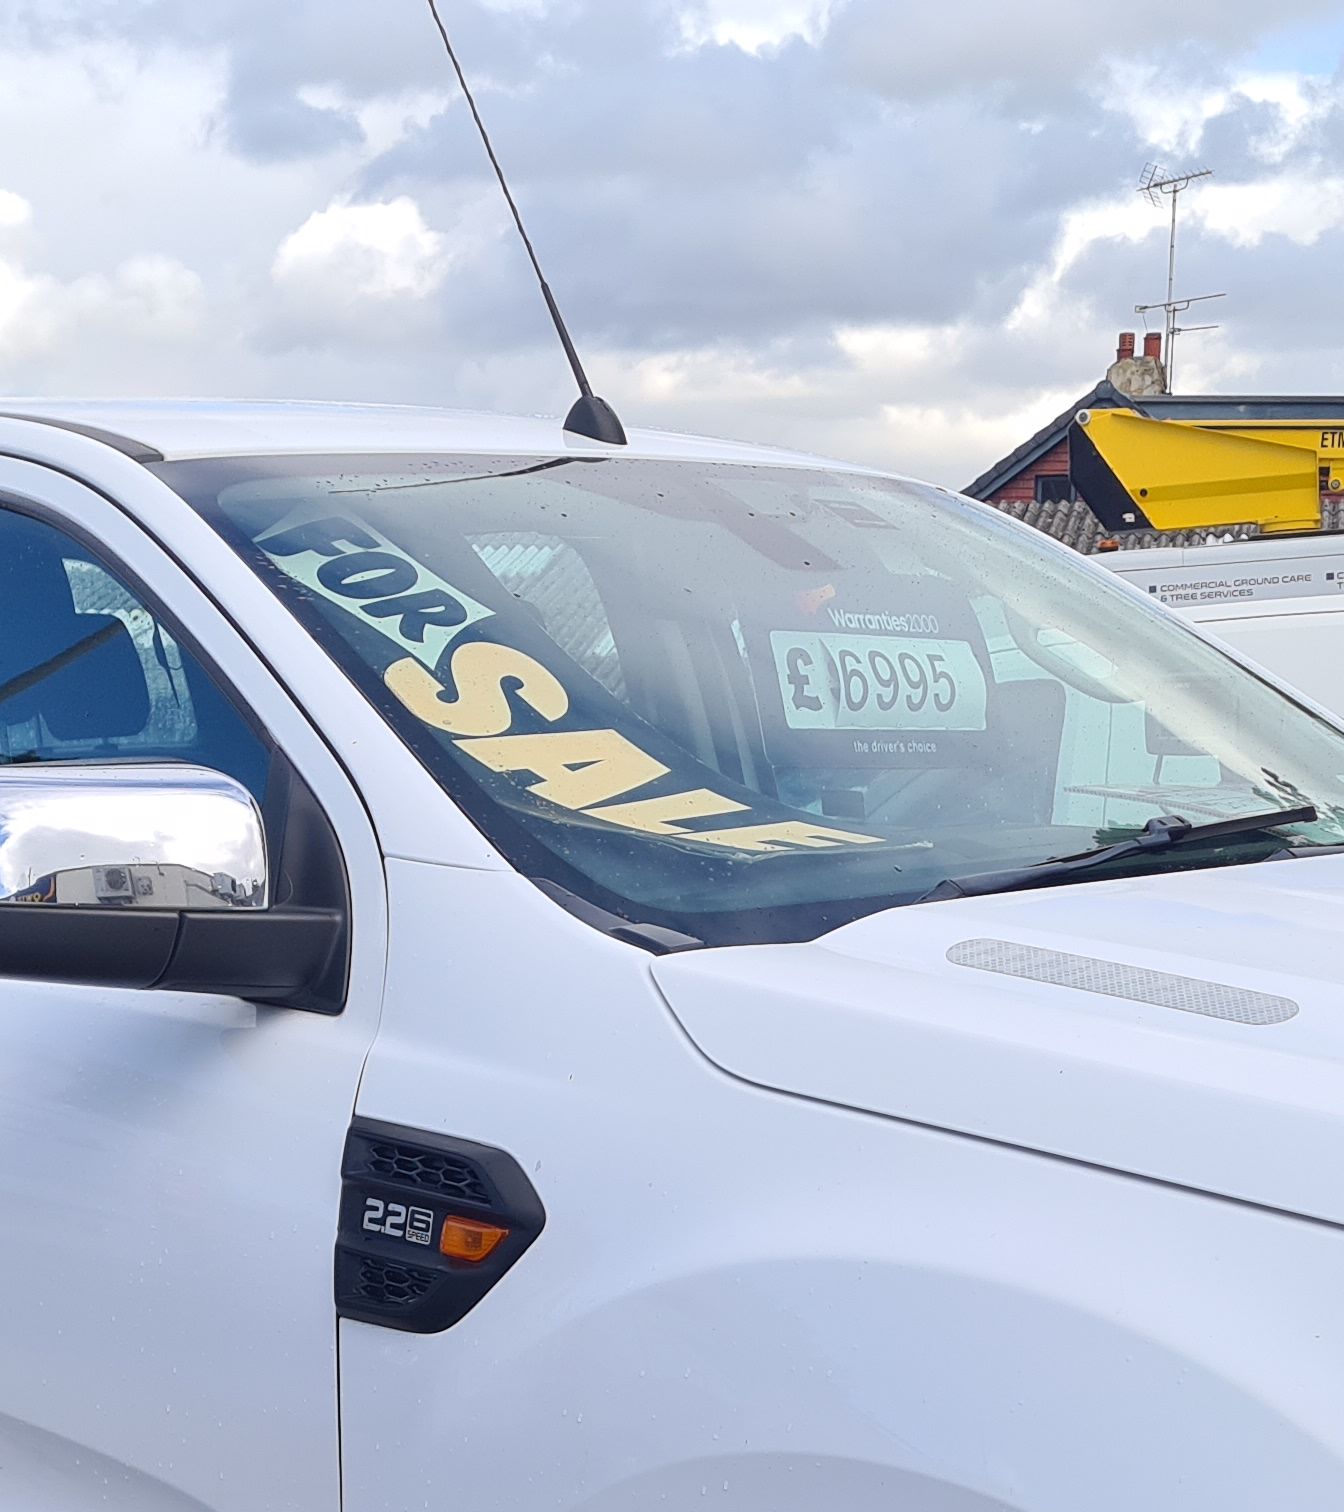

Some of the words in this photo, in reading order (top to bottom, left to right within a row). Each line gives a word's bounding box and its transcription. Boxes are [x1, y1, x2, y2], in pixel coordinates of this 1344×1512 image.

[1160, 580, 1231, 593] COMMERCIAL
[1234, 576, 1280, 588] GROUND
[1282, 573, 1312, 584] CARE
[1169, 591, 1198, 601] TREE
[1200, 588, 1254, 600] SERVICES
[827, 607, 939, 633] Warranties2000
[256, 516, 468, 643] FOR
[384, 641, 887, 852] SALE
[853, 740, 869, 752] the
[871, 740, 904, 753] driver's
[907, 741, 937, 753] choice
[407, 1229, 430, 1243] SPEED
